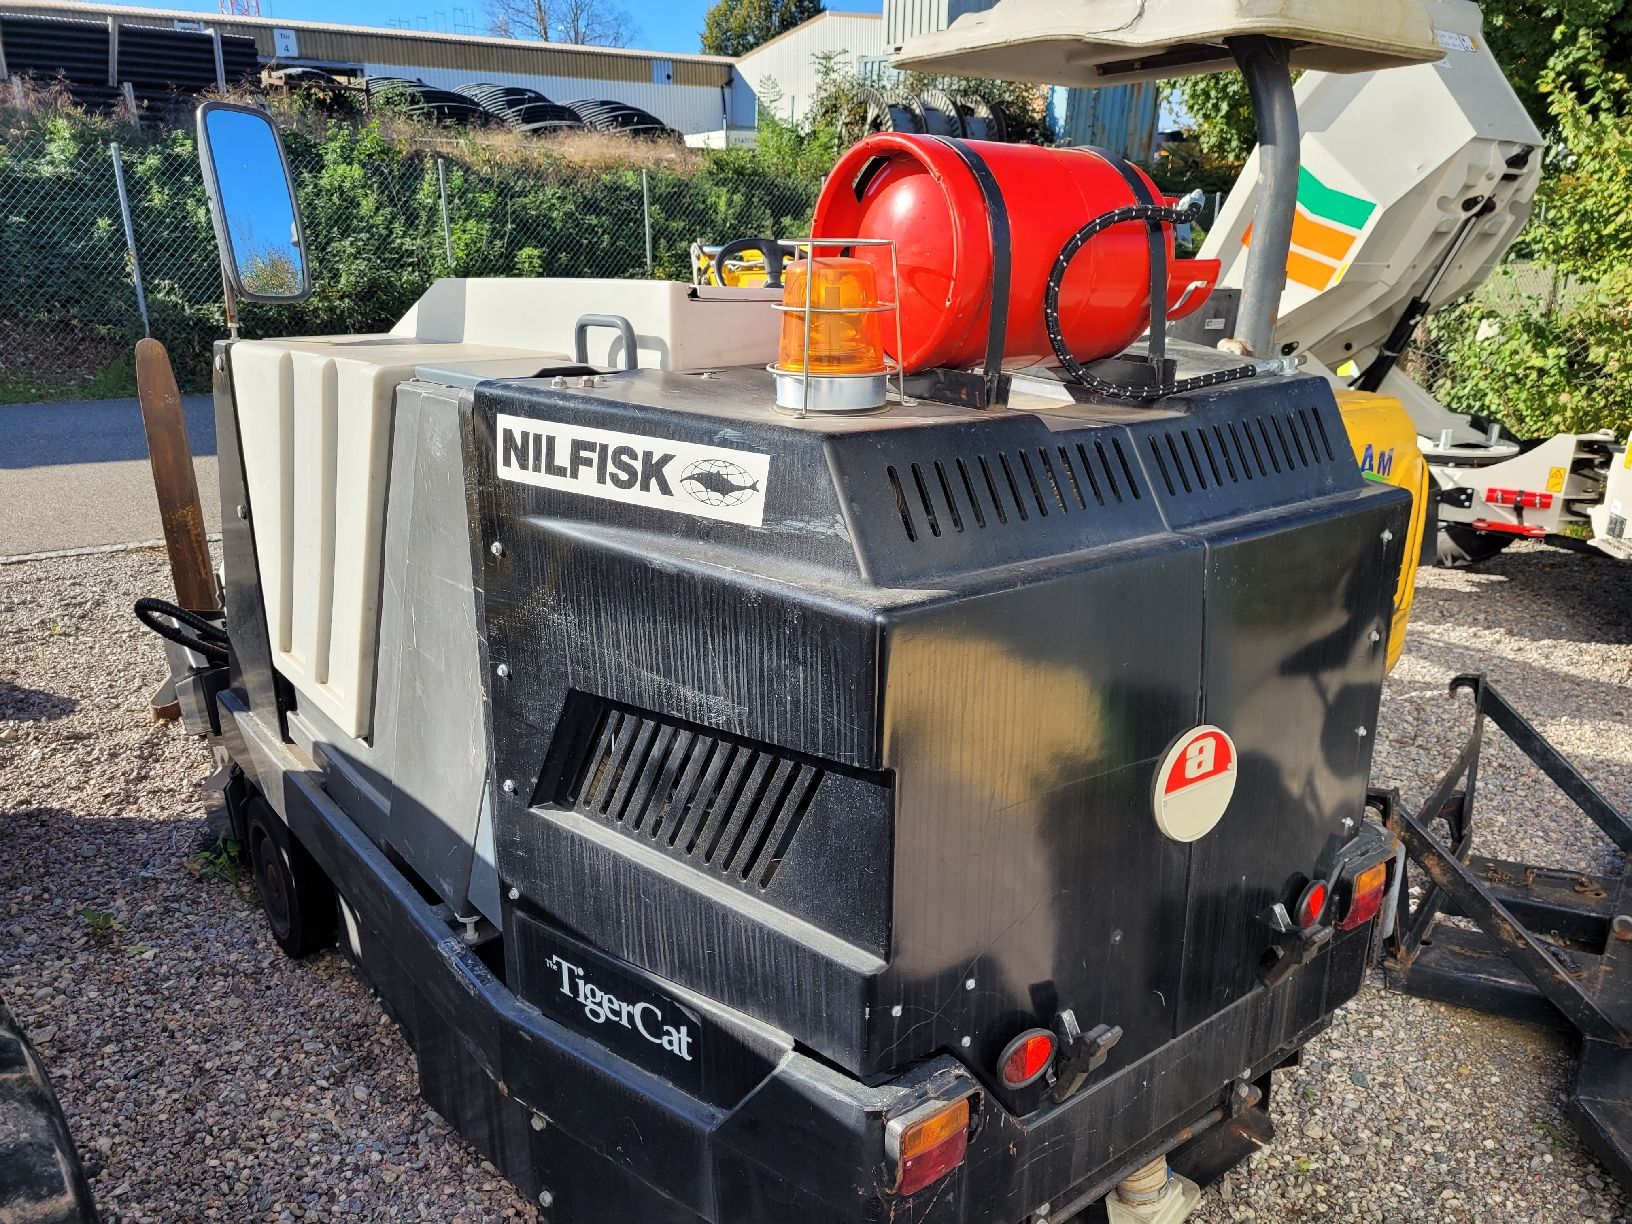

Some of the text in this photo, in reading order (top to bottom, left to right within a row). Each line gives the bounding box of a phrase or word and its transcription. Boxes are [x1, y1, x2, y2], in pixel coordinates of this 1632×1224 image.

[284, 44, 290, 52] 4
[502, 428, 677, 497] NILFISK
[552, 954, 693, 1061] TigerCat
